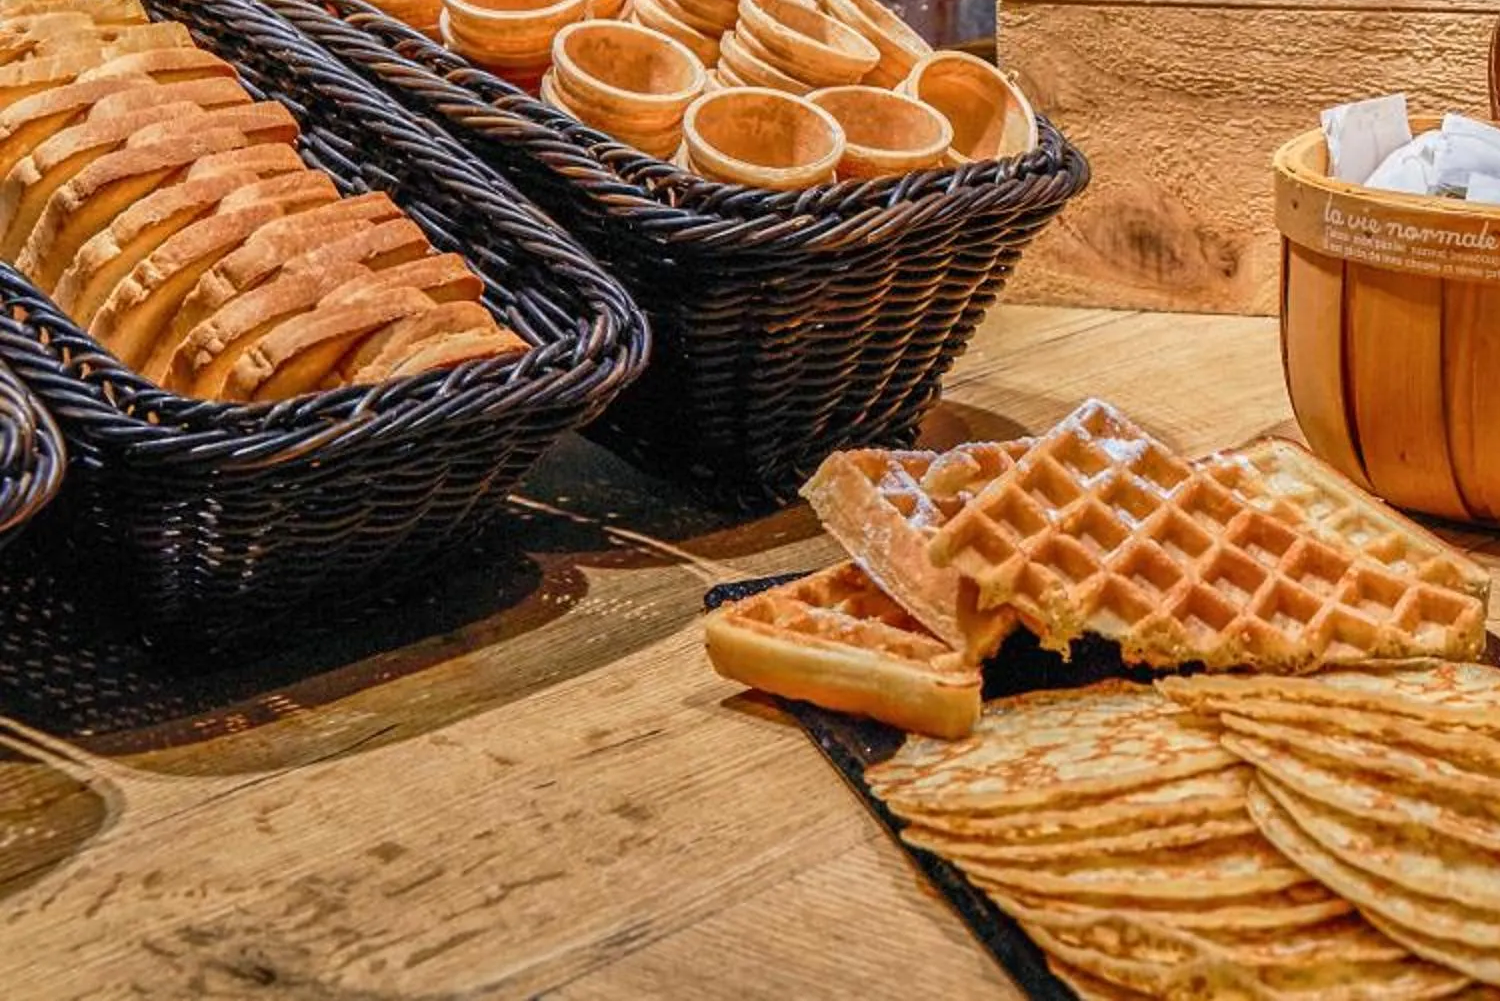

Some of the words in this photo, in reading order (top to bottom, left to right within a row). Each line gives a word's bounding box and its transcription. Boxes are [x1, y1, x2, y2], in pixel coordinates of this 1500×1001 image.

[1324, 193, 1344, 225] la
[1347, 207, 1381, 232] vie
[1386, 220, 1500, 249] normale
